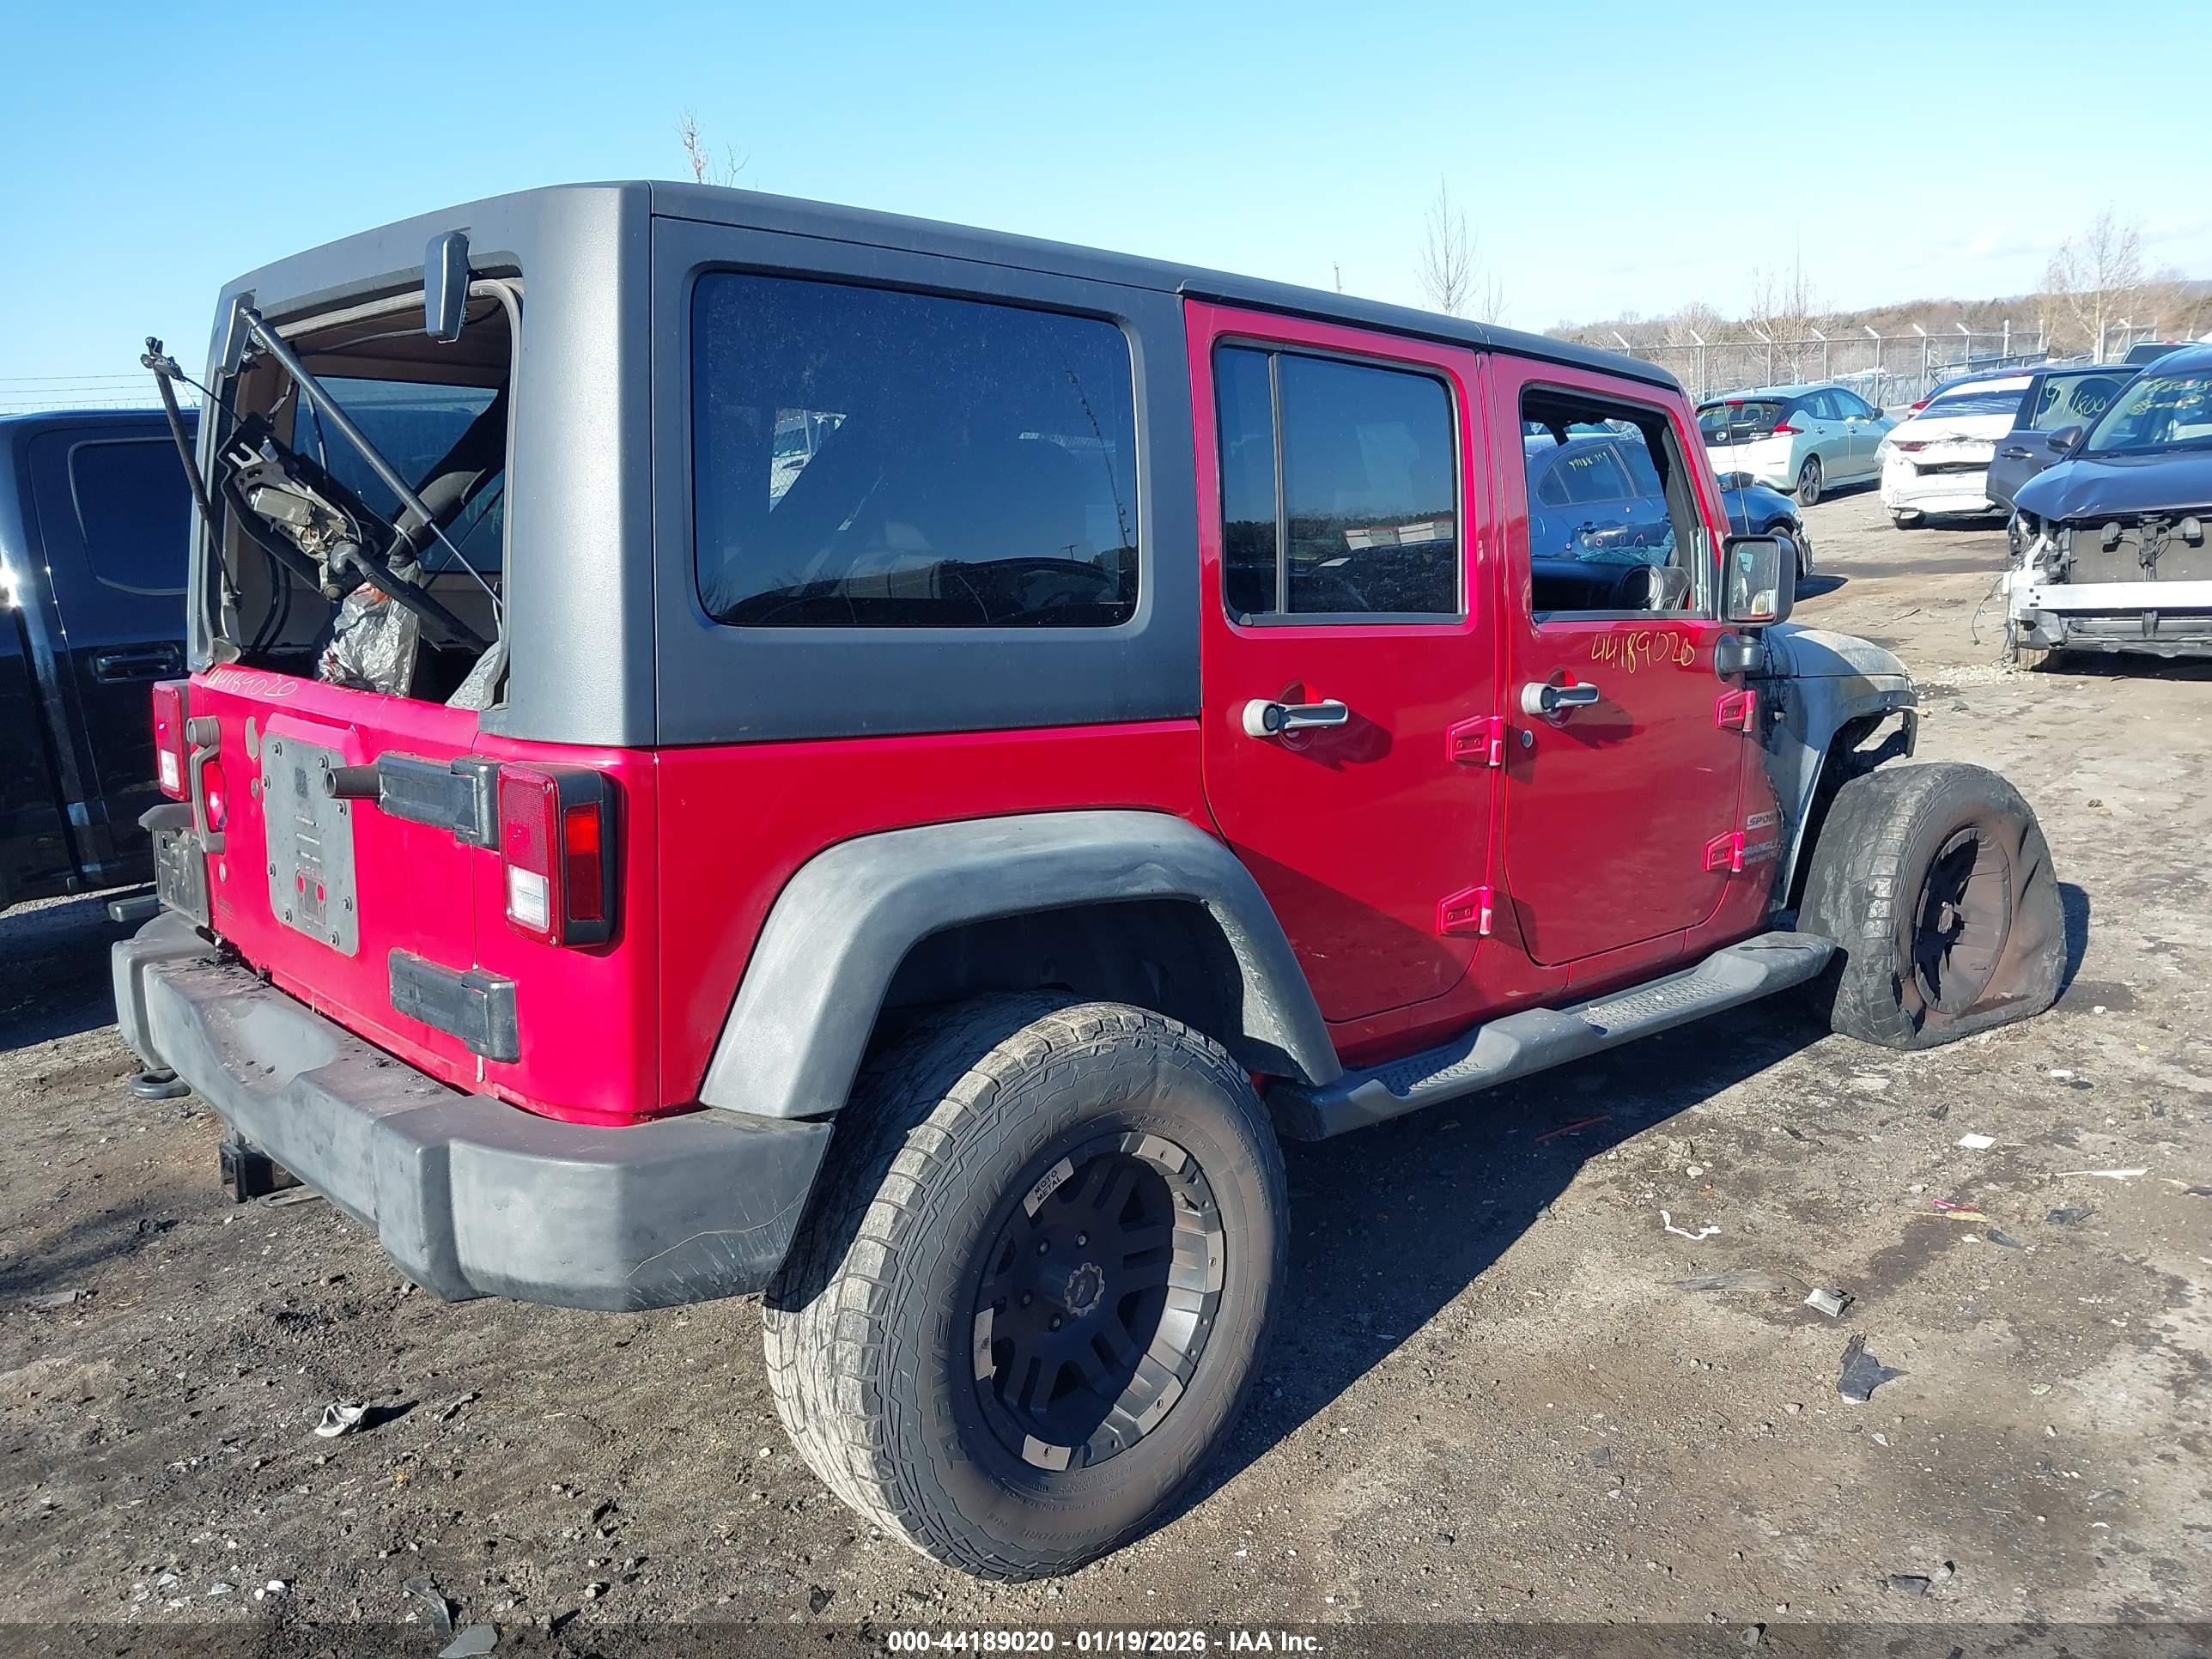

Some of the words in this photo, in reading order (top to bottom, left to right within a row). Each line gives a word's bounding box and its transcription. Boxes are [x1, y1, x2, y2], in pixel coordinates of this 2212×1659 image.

[1591, 630, 1695, 674] 44189020
[1749, 812, 1778, 826] SPOR
[1035, 1170, 1057, 1195] MOTO
[1037, 1176, 1062, 1203] METAL
